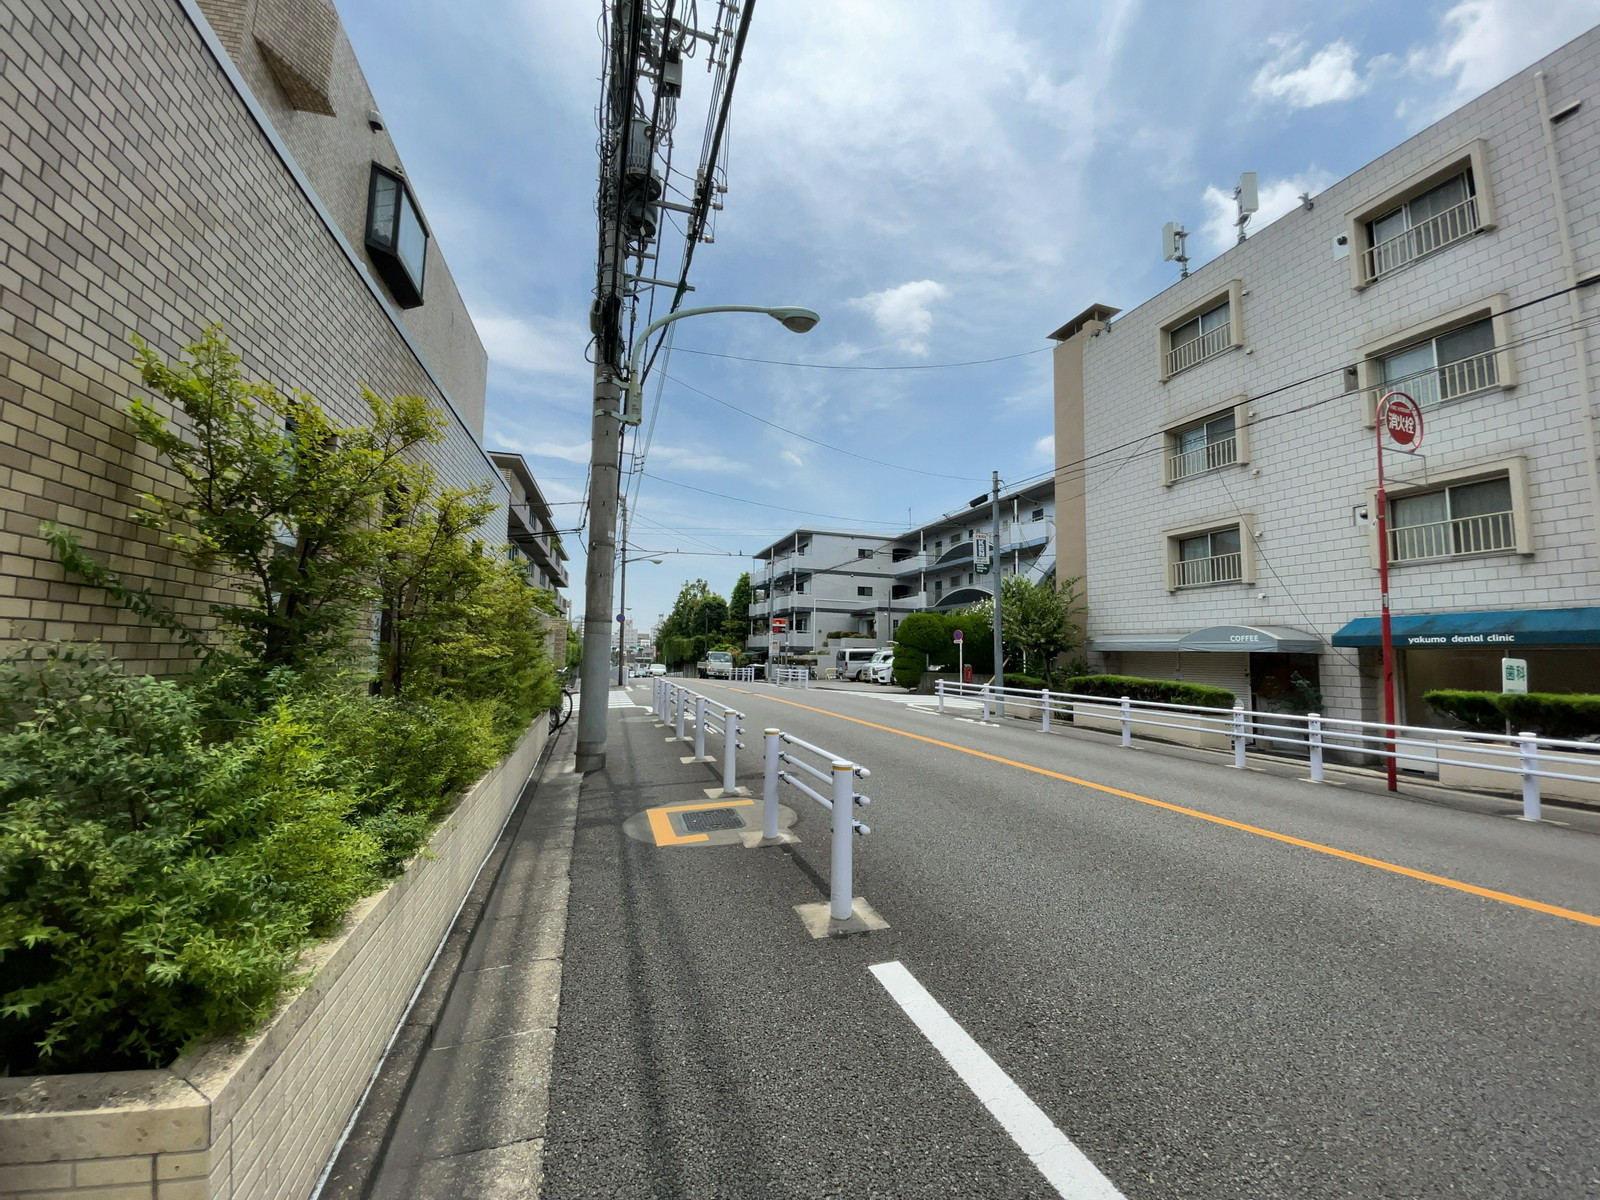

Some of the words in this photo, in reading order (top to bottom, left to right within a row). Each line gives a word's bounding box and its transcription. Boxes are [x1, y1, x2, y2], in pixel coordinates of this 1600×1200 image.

[1388, 412, 1414, 434] 消火栓
[1408, 636, 1447, 644] yakumo
[1451, 635, 1484, 643] dental
[1487, 634, 1515, 642] clinic
[1506, 665, 1525, 681] 歯科
